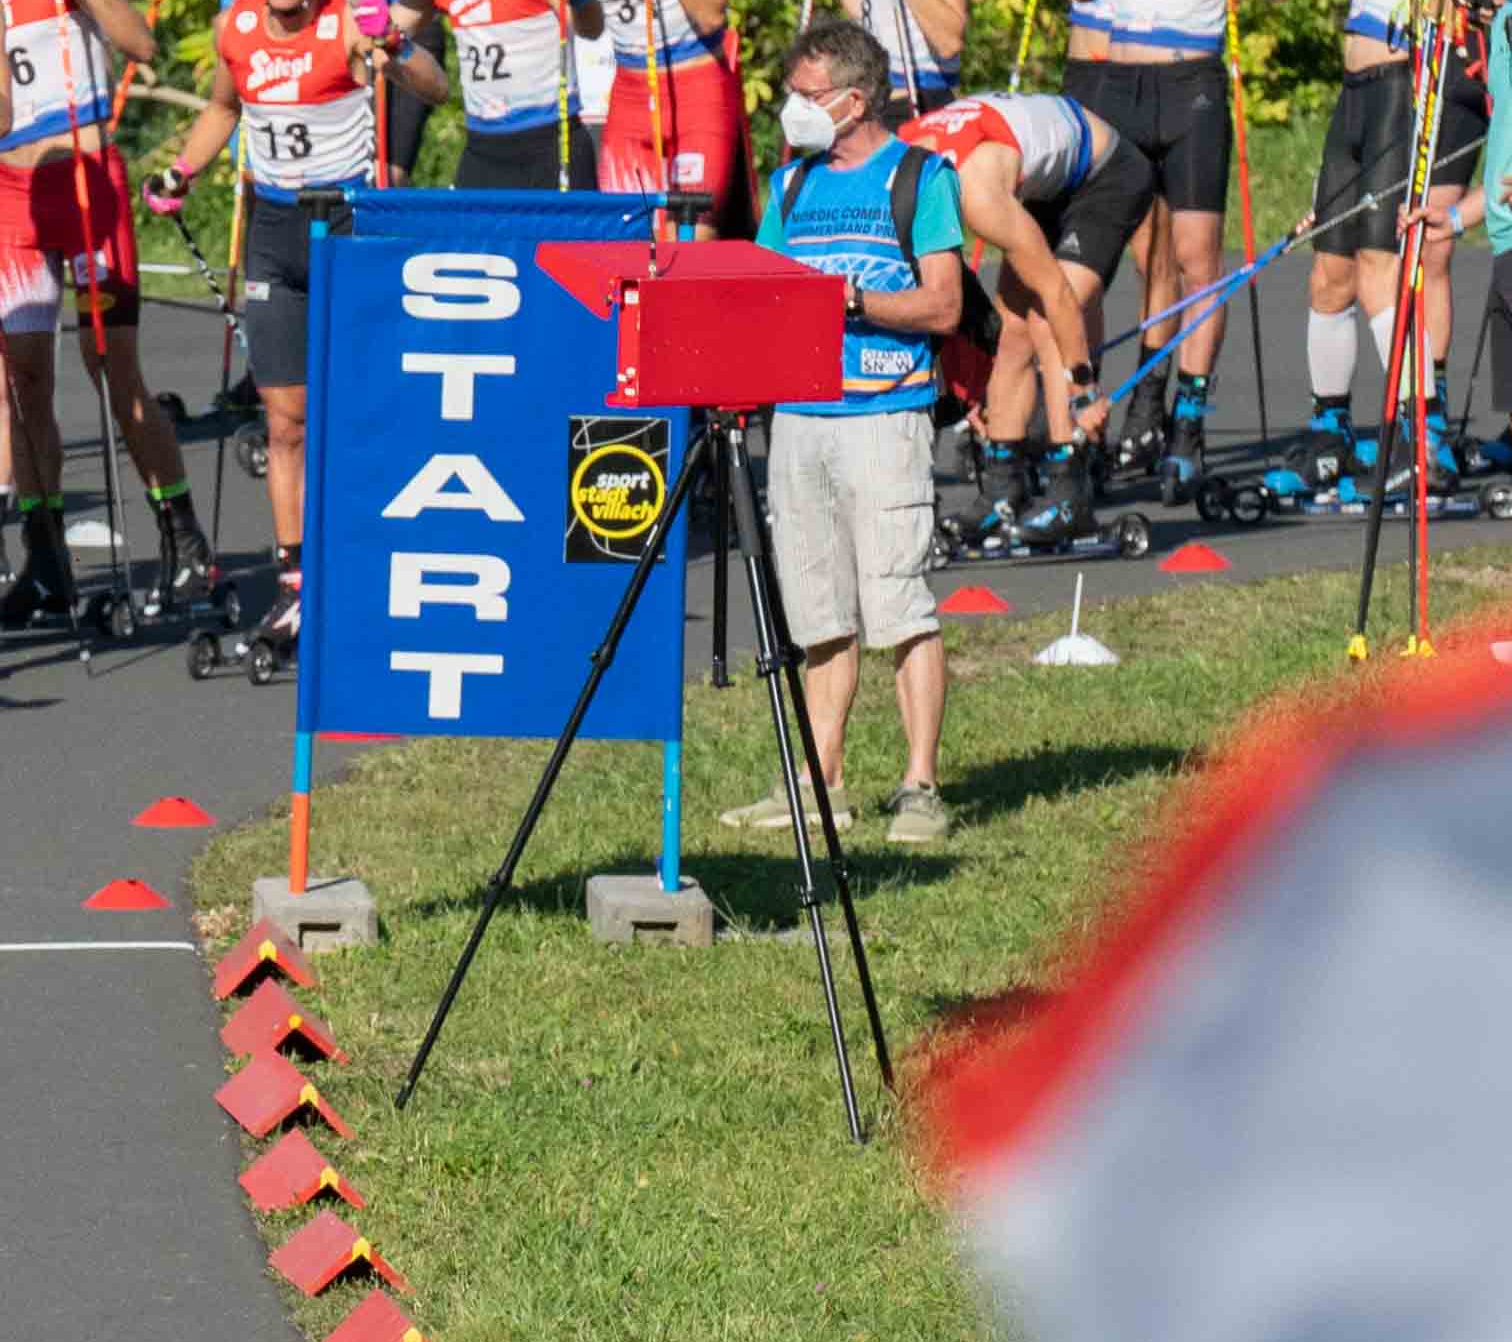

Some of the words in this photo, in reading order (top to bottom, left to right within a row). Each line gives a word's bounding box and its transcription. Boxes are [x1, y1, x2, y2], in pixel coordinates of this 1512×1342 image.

[466, 43, 512, 83] 22
[259, 121, 312, 161] 13
[379, 252, 526, 720] START
[596, 471, 651, 491] sport
